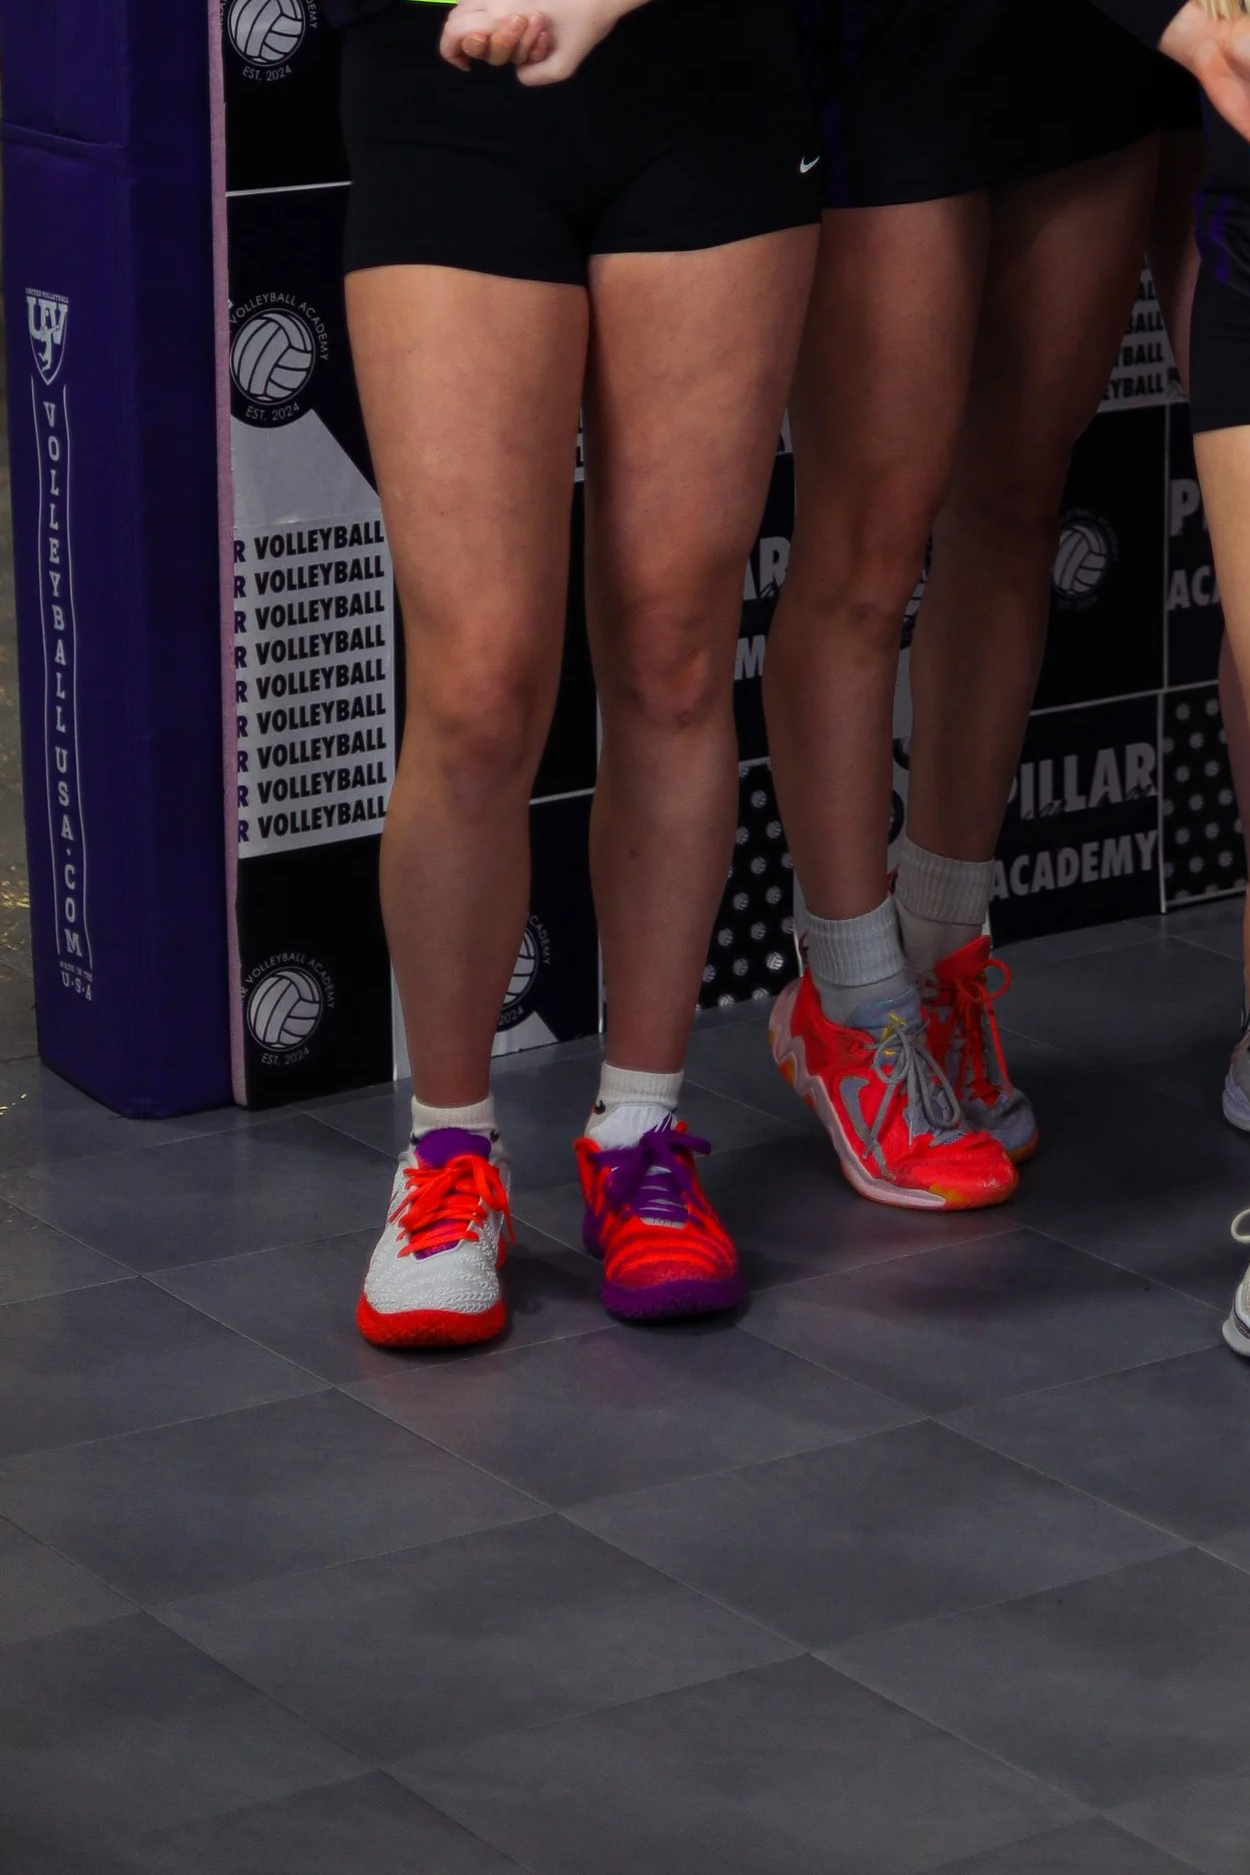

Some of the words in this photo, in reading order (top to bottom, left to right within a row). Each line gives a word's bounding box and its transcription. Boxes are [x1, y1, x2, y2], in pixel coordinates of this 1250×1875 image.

[229, 292, 297, 325] VOLLEYBALL
[298, 301, 330, 361] ACADEMY
[255, 521, 384, 560] VOLLEYBALL
[255, 555, 385, 595] VOLLEYBALL
[256, 589, 385, 630] VOLLEYBALL
[256, 624, 385, 664] VOLLEYBALL
[256, 658, 385, 699] VOLLEYBALL
[257, 692, 385, 734] VOLLEYBALL
[257, 727, 385, 769] VOLLEYBALL
[258, 761, 386, 804] VOLLEYBALL
[1008, 741, 1158, 821] ILLAR
[258, 796, 386, 839] VOLLEYBALL
[245, 953, 306, 983] VOLLEYBALL
[308, 959, 336, 1008] ACADEMY
